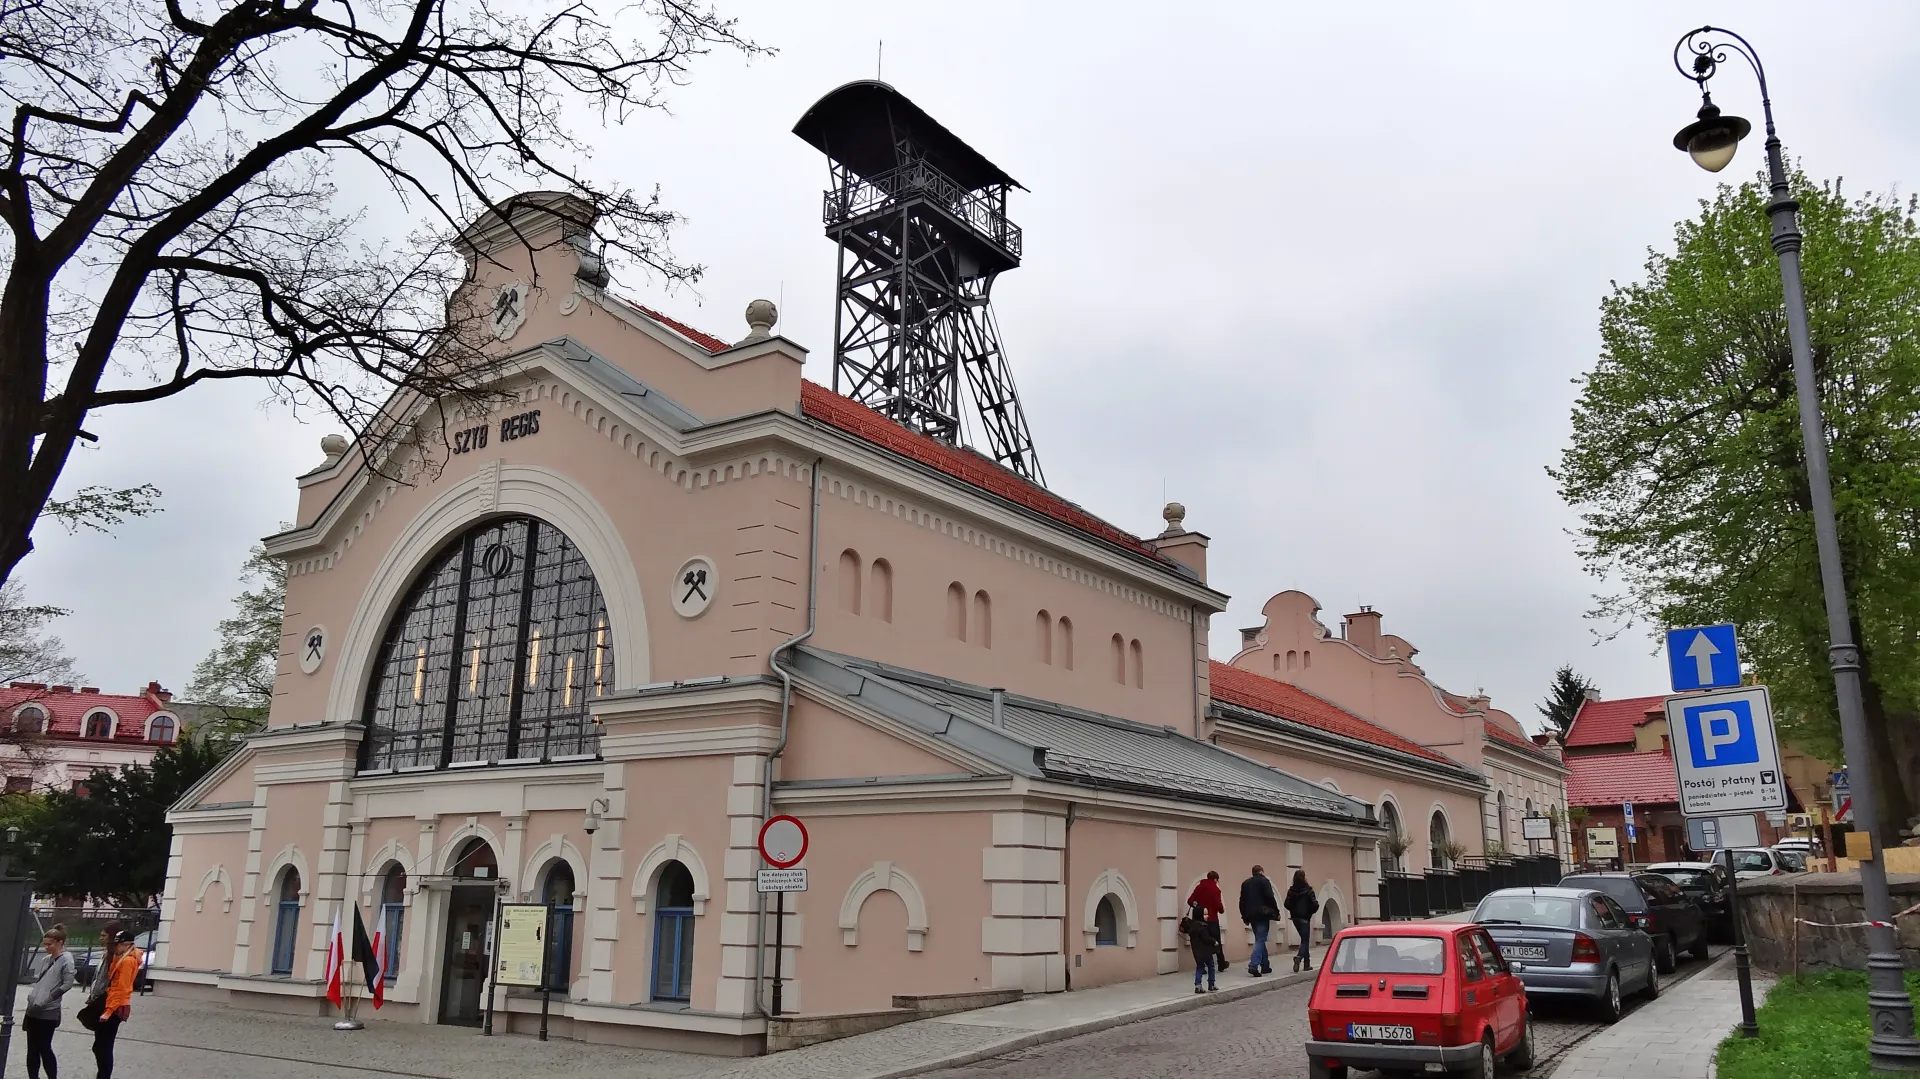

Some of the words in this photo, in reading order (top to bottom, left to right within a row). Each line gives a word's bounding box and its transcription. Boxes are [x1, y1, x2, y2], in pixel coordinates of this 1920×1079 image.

[453, 424, 489, 454] SZYB
[500, 409, 541, 442] REGIS
[1698, 709, 1740, 760] P
[1683, 777, 1716, 788] Postój
[1721, 776, 1755, 787] płatny
[1733, 789, 1754, 797] piątek
[1501, 946, 1516, 955] KWI
[1518, 947, 1544, 957] 08546
[1353, 1025, 1373, 1038] KWI
[1379, 1026, 1413, 1039] 15678
